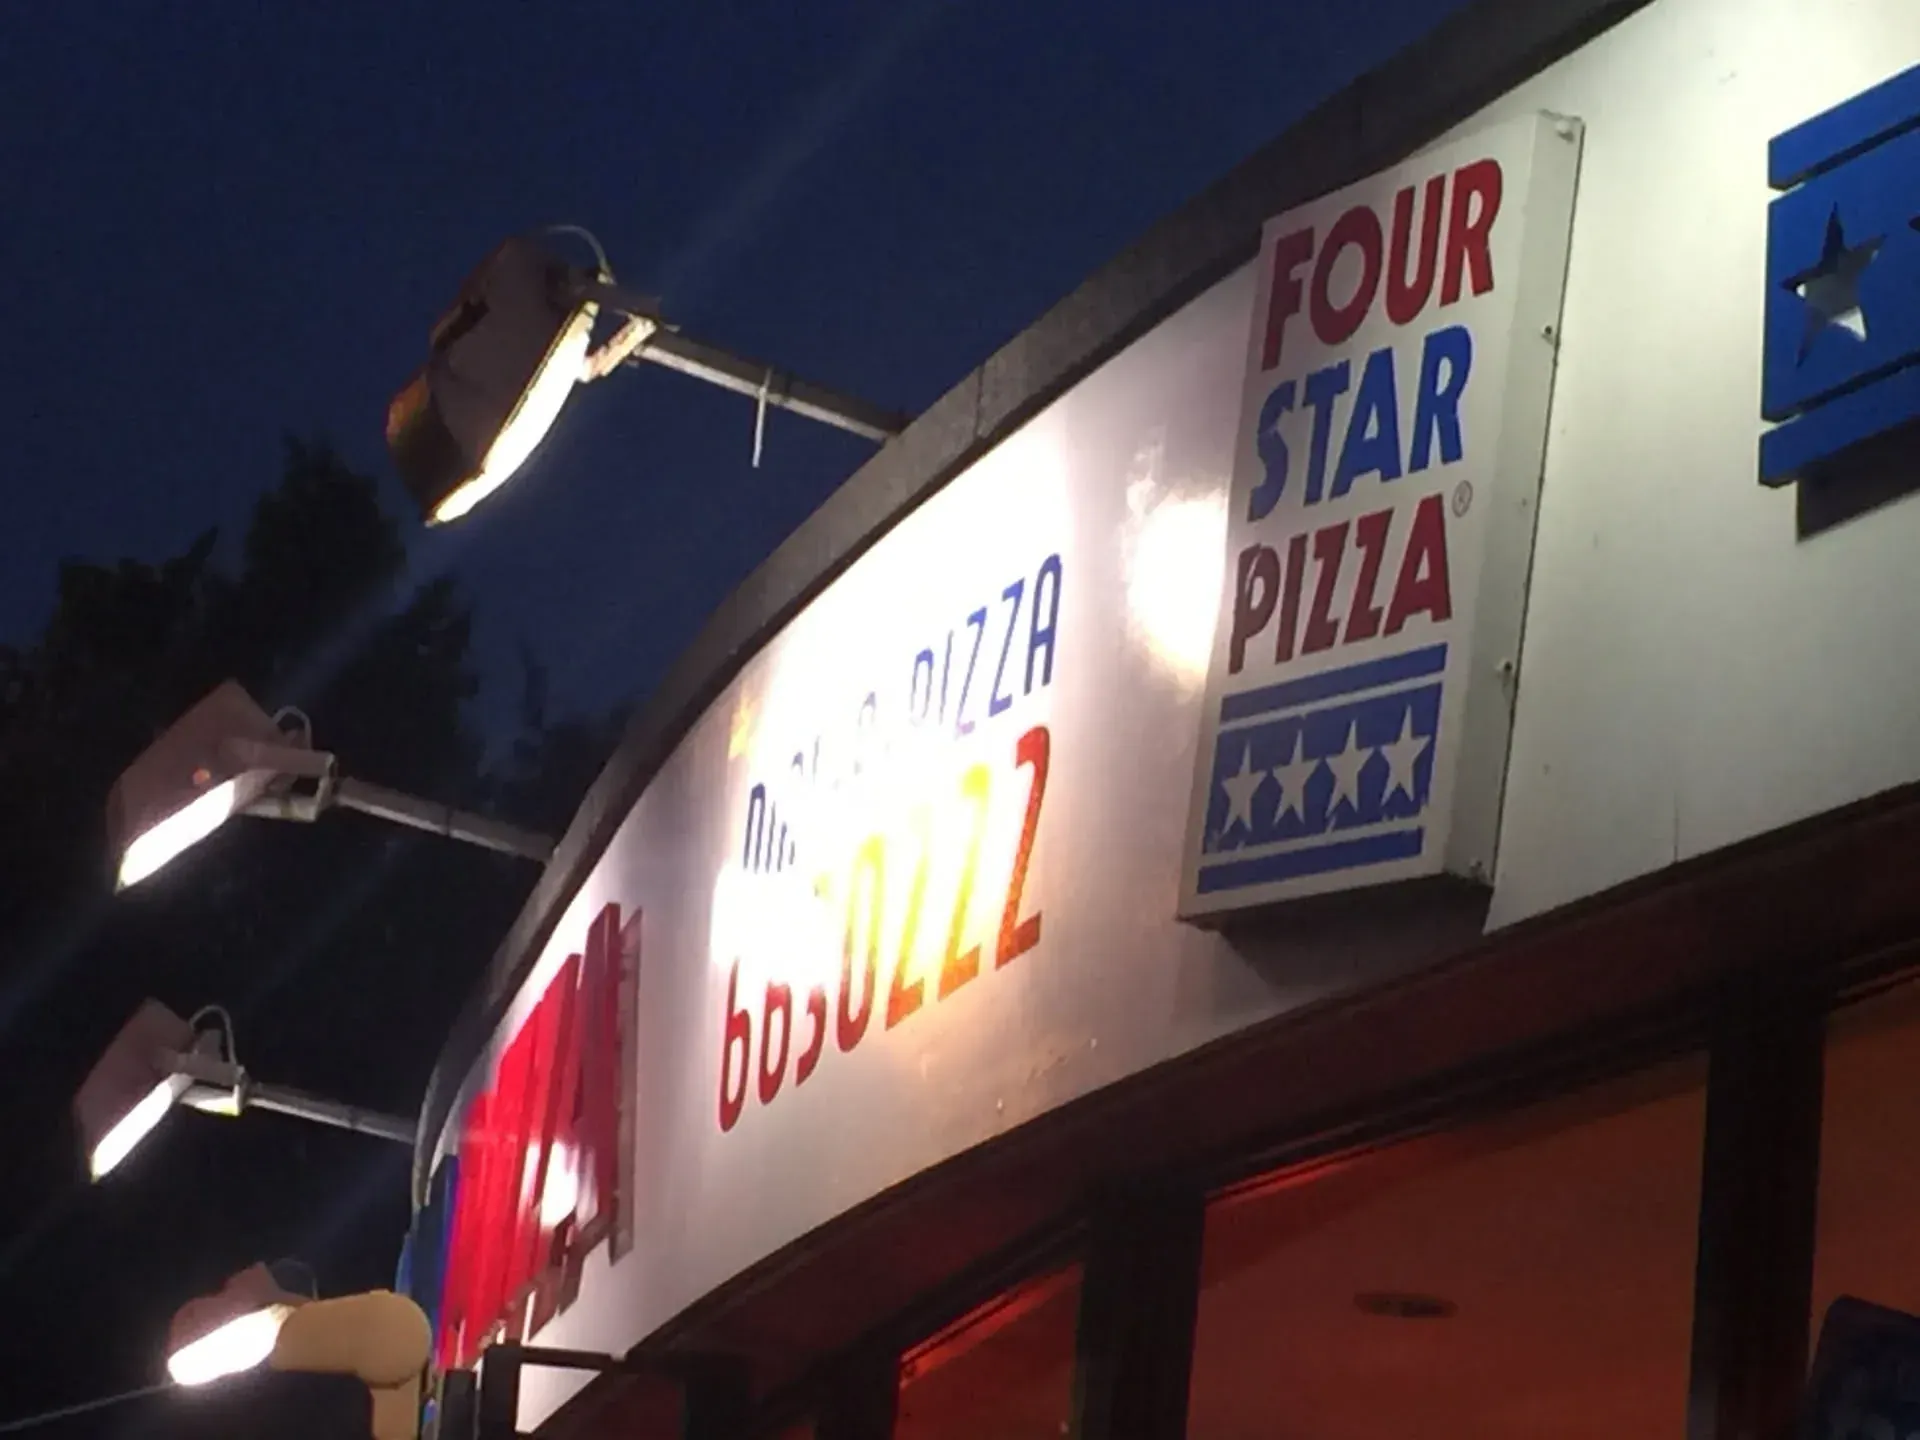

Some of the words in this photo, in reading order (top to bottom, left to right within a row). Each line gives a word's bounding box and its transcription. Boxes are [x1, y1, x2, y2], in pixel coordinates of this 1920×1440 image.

[1262, 158, 1502, 370] FOUR
[1248, 324, 1473, 522] STAR
[1228, 493, 1453, 675] PIZZA
